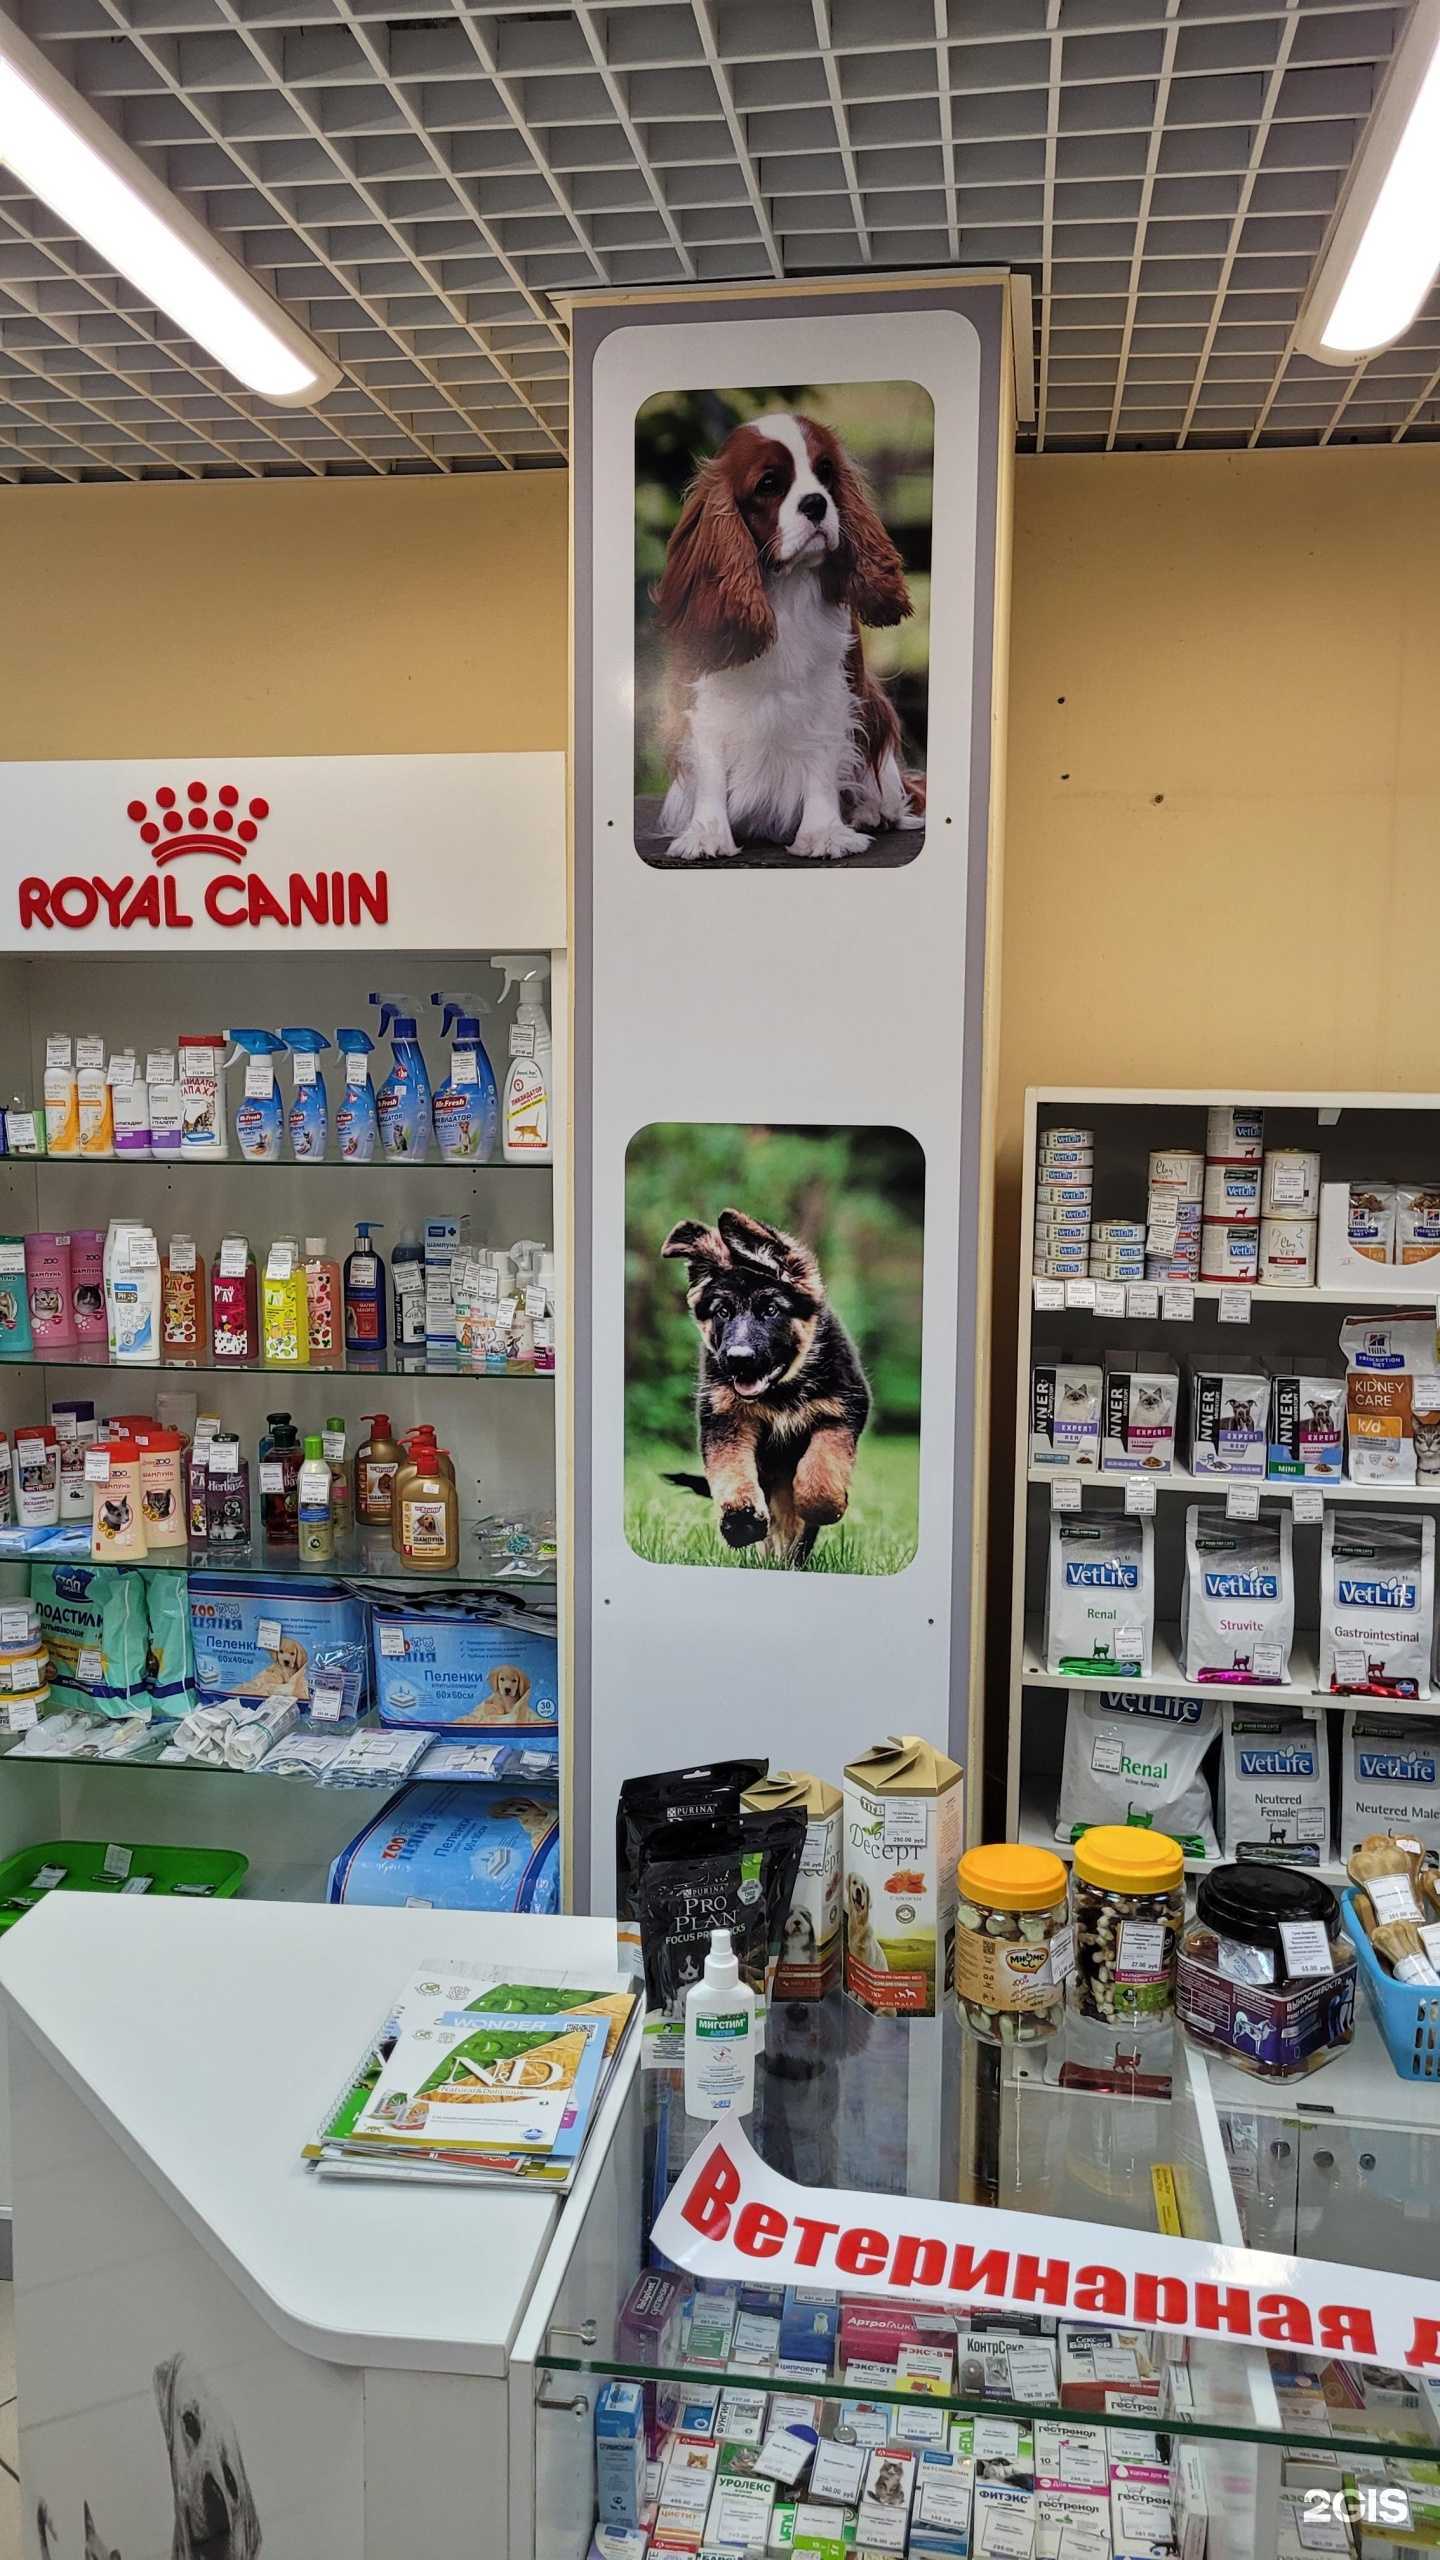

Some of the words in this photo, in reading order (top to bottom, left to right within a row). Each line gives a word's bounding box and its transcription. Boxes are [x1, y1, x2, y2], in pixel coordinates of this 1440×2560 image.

[18, 874, 194, 930] ROYAL
[204, 870, 389, 928] CANIN
[1355, 1378, 1404, 1394] KIDNEY
[1355, 1393, 1393, 1408] CARE
[1061, 1424, 1093, 1432] EXPERT
[1136, 1429, 1166, 1437] EXPERT
[1357, 1418, 1382, 1433] k/d
[1308, 1434, 1338, 1442] EXPERT
[1069, 1563, 1136, 1587] VetLife
[1206, 1574, 1274, 1596] VetLife
[1341, 1581, 1413, 1608] VetLife
[1087, 1608, 1117, 1620] Renal
[1220, 1618, 1264, 1632] Struvite
[1334, 1625, 1420, 1643] Gastrointestinal
[424, 1669, 483, 1682] Пеленки
[540, 1701, 551, 1710] 30
[1106, 1690, 1199, 1721] VetLife
[1120, 1754, 1168, 1780] Renal
[1242, 1750, 1313, 1775] VetLife
[1362, 1754, 1435, 1782] VetLife
[1255, 1792, 1302, 1805] Neutered
[677, 1805, 714, 1816] PURINA
[1261, 1806, 1297, 1818] Female
[1355, 1801, 1408, 1817] Neutered
[1412, 1805, 1440, 1820] Male
[433, 1816, 474, 1858] Пеленки
[692, 1884, 725, 1897] PURINA
[685, 1895, 728, 1916] PRO
[674, 1909, 738, 1933] PLAN
[665, 1932, 696, 1945] FOCUS
[1287, 1978, 1343, 2011] ВЫНОСЛИВОСТЬ
[453, 2017, 548, 2031] WONDER
[699, 2018, 745, 2030] МИГСТИМ
[442, 2055, 564, 2088] N&D
[680, 2143, 1378, 2356] Ветеринарная
[967, 2337, 1024, 2357] КонтрСекс
[1069, 2341, 1111, 2350] Барьер
[1040, 2457, 1051, 2465] 10
[719, 2477, 772, 2493] УРОЛЕКС
[979, 2489, 1029, 2504] ФИТЭКС
[1040, 2513, 1051, 2521] 10
